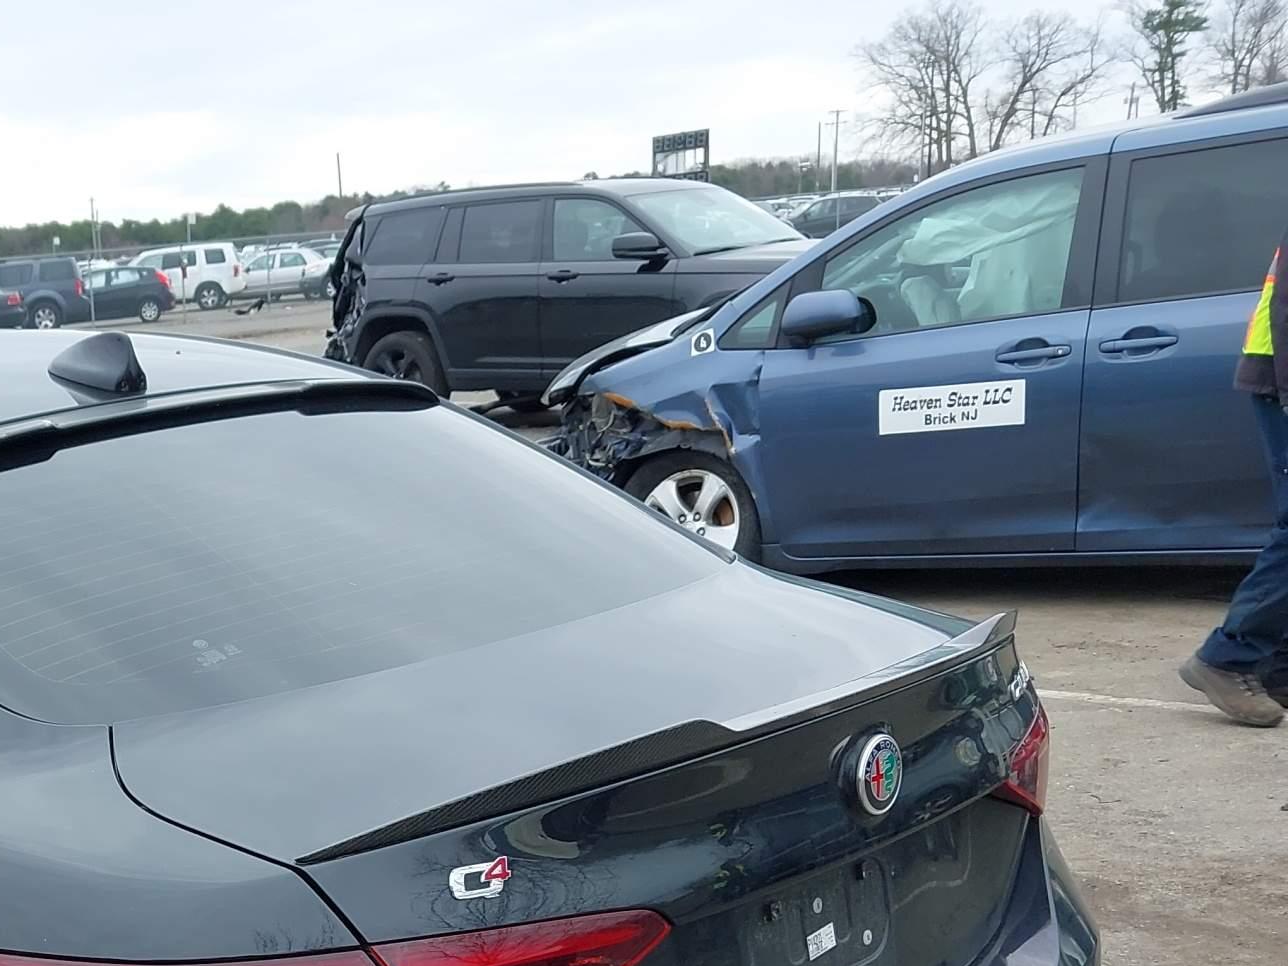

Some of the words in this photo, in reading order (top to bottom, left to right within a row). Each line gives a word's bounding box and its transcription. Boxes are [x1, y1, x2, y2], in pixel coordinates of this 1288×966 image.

[892, 395, 942, 412] Heaven
[946, 392, 978, 408] Star
[982, 387, 1014, 406] LLC
[924, 413, 957, 426] Brick
[961, 409, 979, 422] NJ
